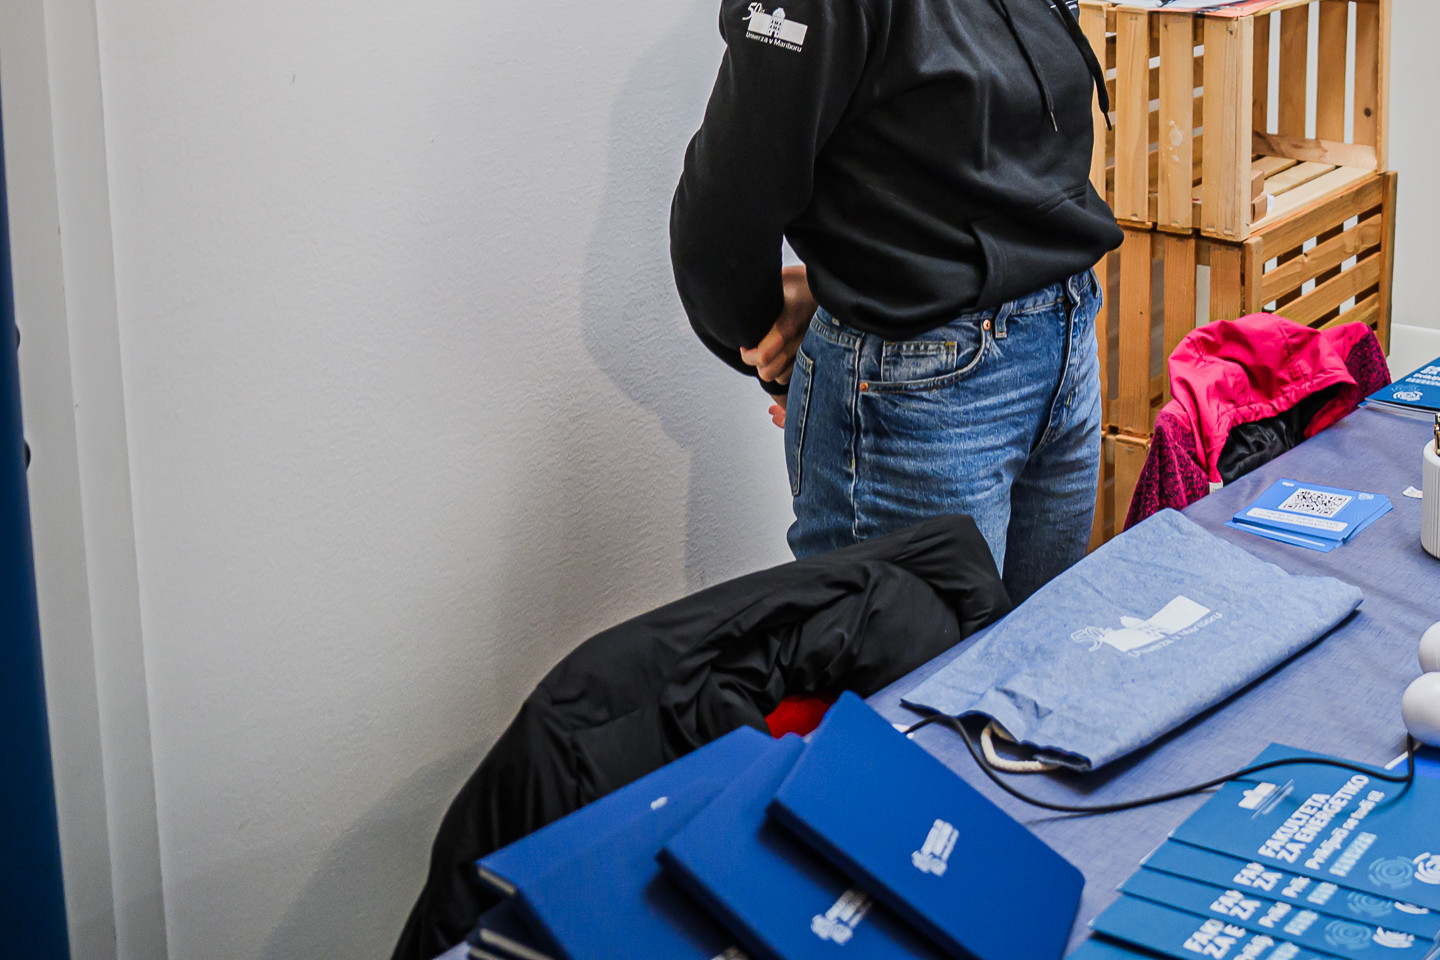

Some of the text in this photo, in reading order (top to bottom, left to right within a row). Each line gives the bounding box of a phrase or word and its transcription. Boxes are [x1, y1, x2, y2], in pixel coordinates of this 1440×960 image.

[1257, 792, 1331, 858] FAKULTETA
[1276, 840, 1307, 864] ZA
[1294, 774, 1370, 843] ENERGETIKO
